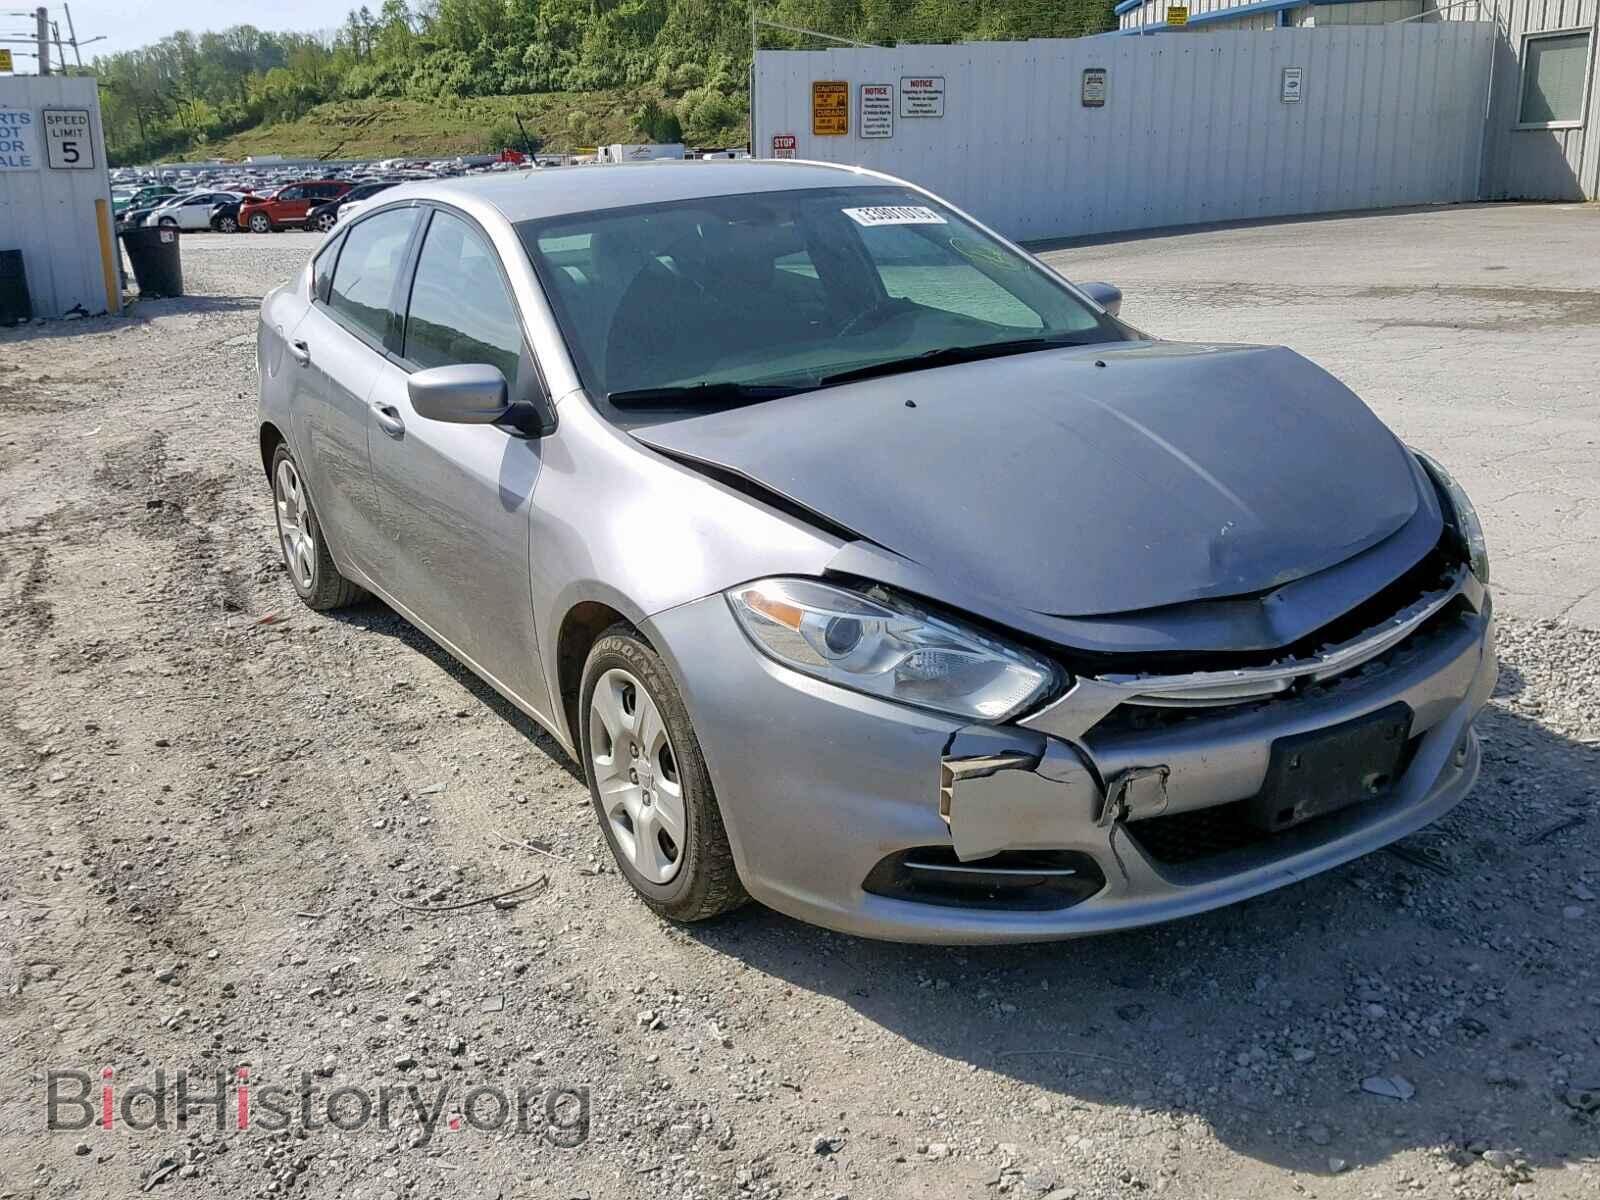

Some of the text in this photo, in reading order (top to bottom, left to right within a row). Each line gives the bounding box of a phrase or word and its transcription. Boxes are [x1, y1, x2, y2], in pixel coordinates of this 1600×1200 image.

[910, 79, 934, 88] NOTICE
[864, 87, 888, 96] NOTICE
[47, 115, 87, 125] SPEED
[52, 128, 83, 138] LIMIT
[774, 138, 794, 148] STOP
[62, 141, 80, 163] 5
